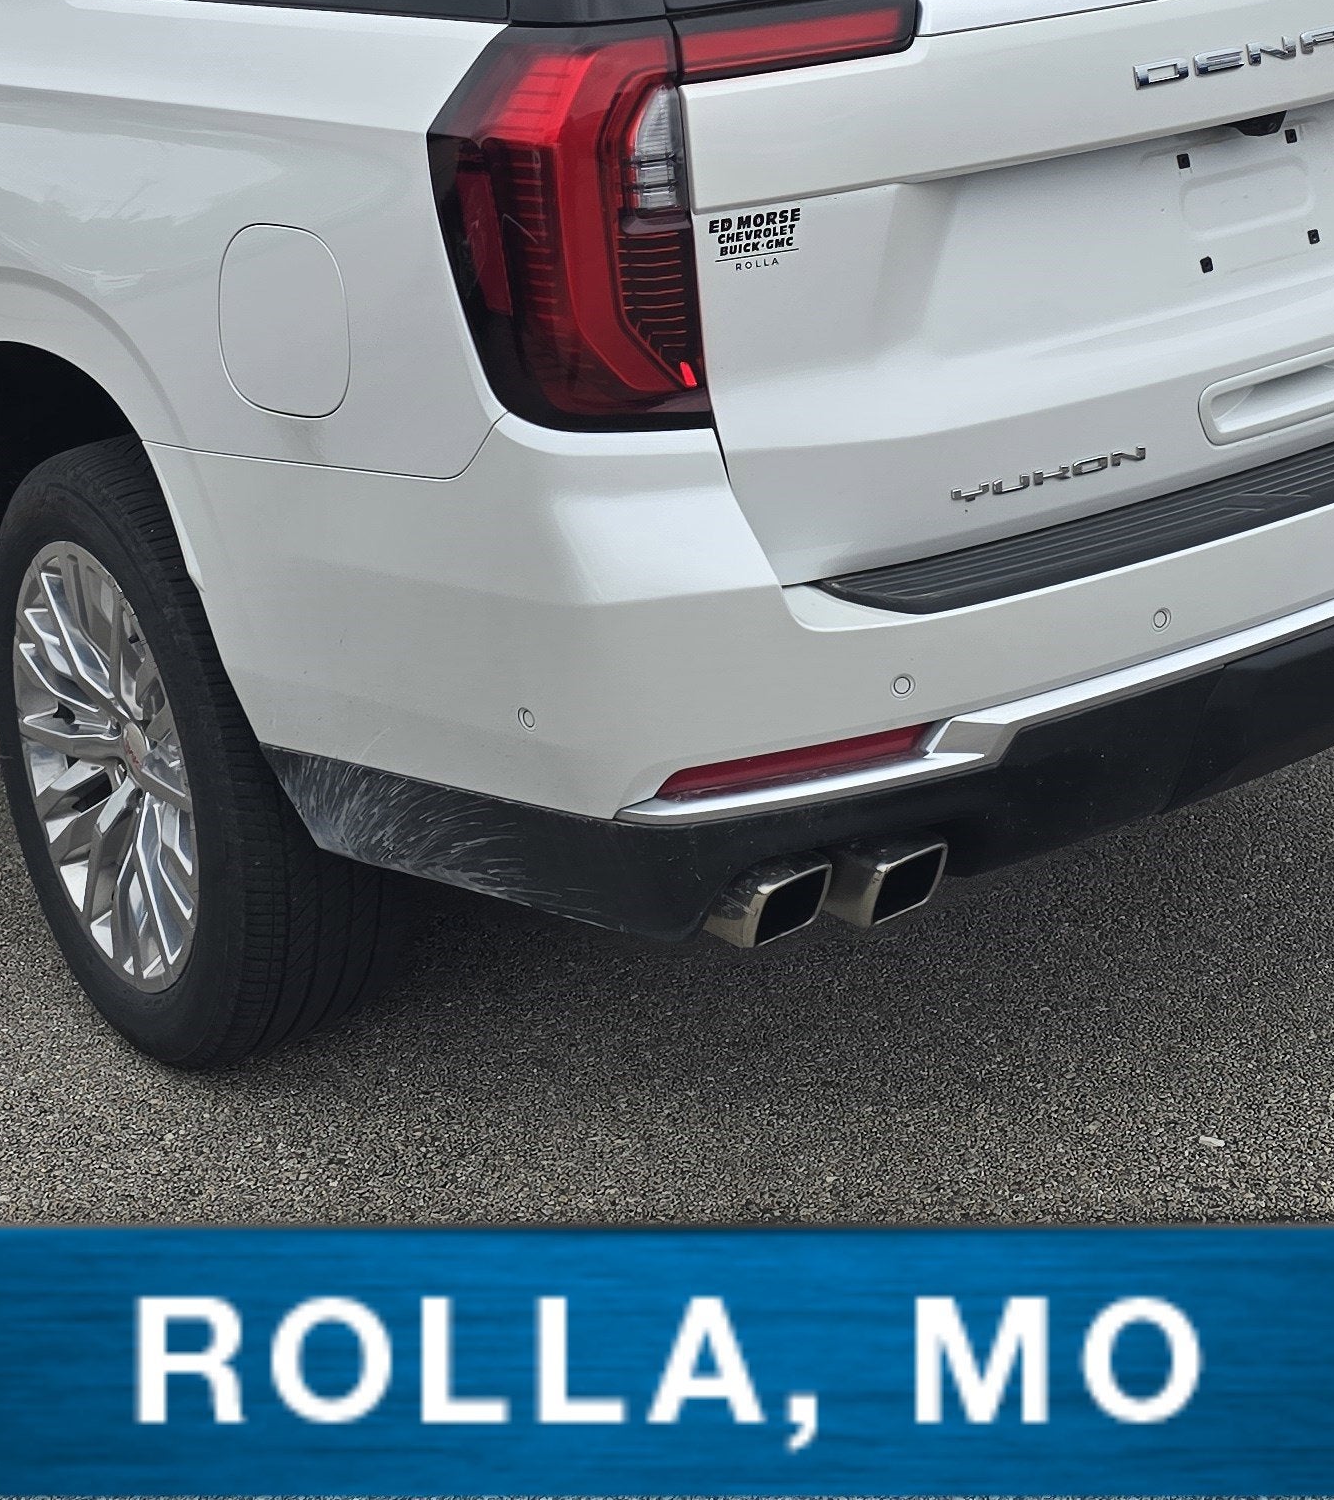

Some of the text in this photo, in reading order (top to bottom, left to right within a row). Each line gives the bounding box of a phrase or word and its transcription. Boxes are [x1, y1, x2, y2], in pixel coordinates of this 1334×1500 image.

[709, 207, 801, 234] ED MORSE
[717, 223, 796, 245] CHEVROLET
[735, 257, 779, 271] ROLLA
[950, 445, 1147, 503] YUKON
